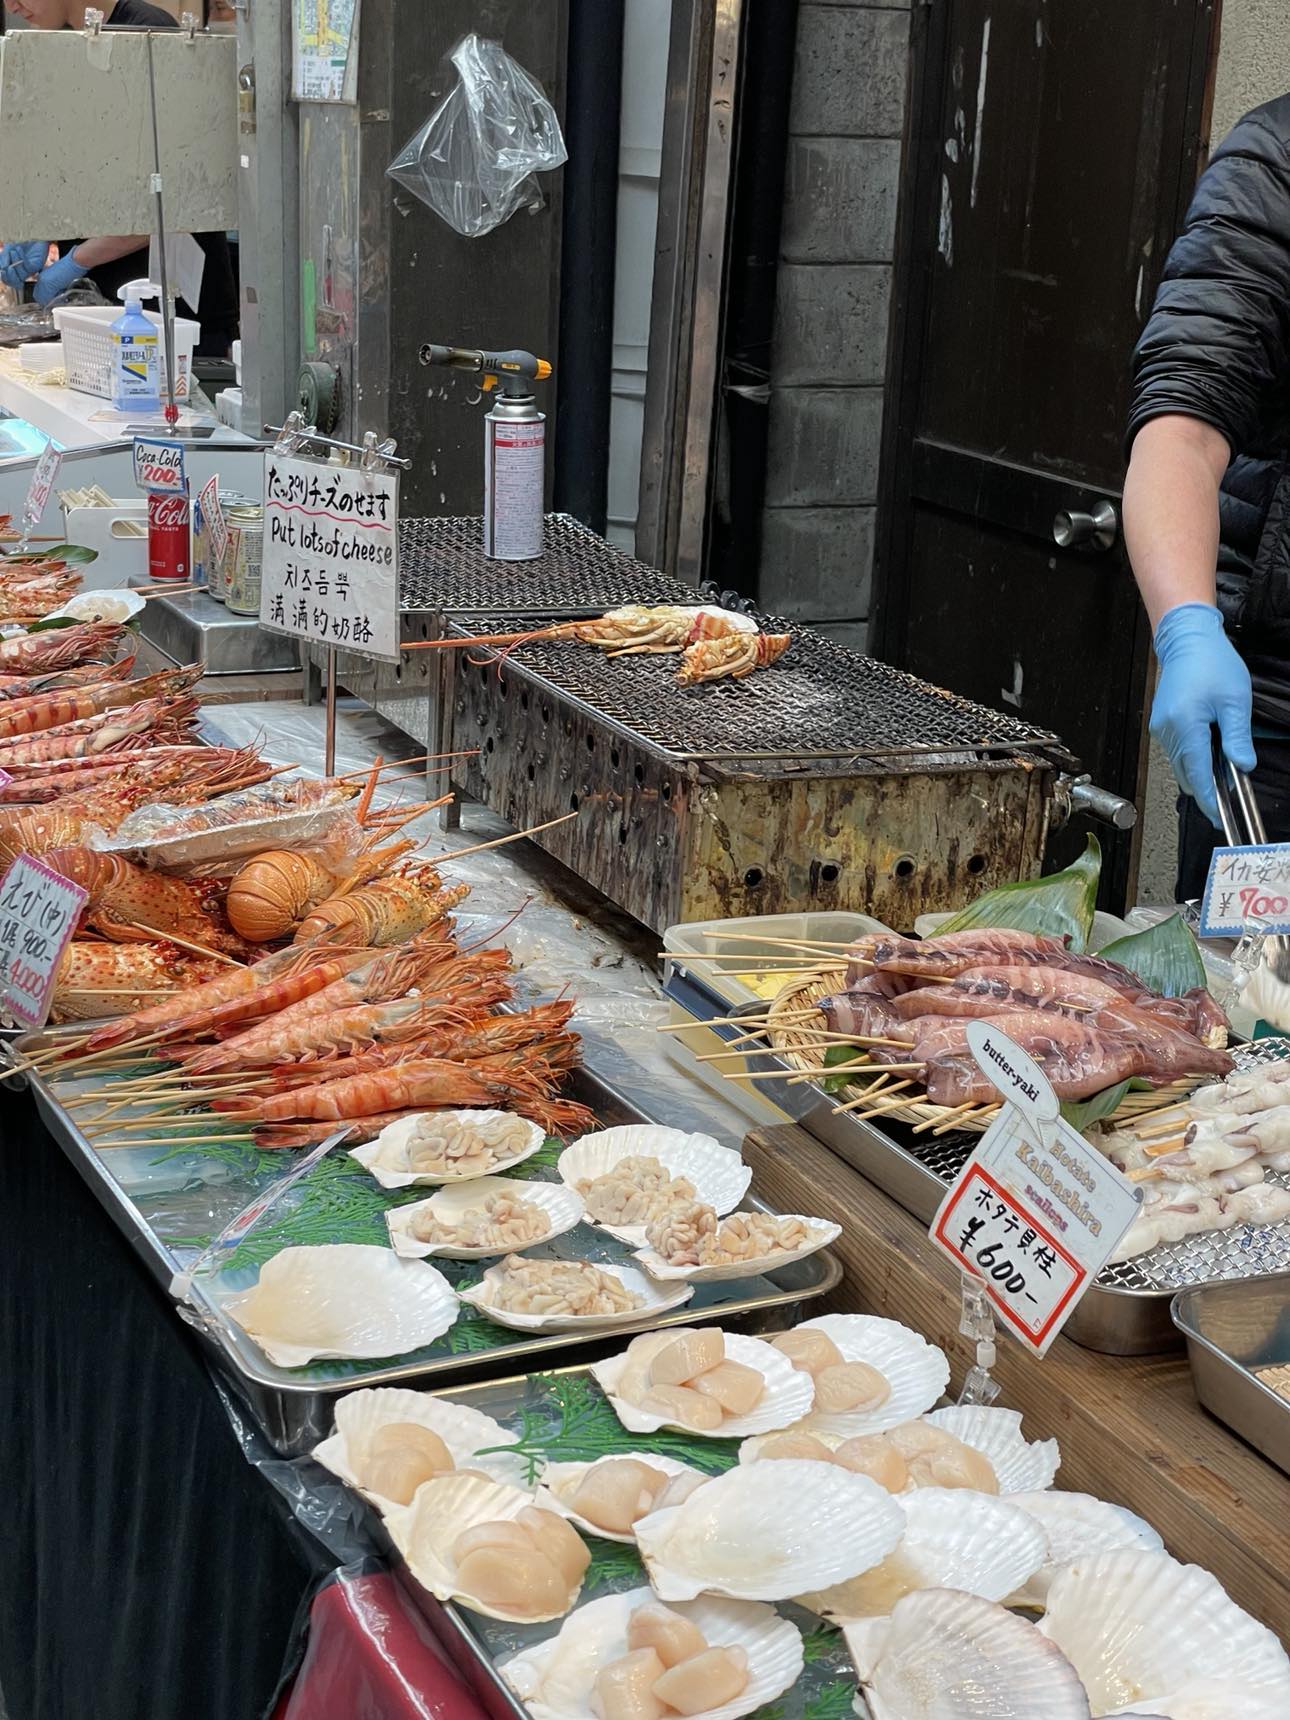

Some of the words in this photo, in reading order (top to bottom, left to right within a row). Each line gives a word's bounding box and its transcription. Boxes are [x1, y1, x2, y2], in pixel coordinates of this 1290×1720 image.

[136, 444, 182, 468] Coca-Cola
[267, 464, 391, 521] たっぷりチーズのせます
[271, 516, 296, 548] Put
[981, 1038, 1041, 1103] butter-yaki
[1014, 1139, 1104, 1238] Kaibashira
[1050, 1139, 1097, 1193] Hotate
[974, 1188, 1057, 1280] ホタテ貝柱
[1024, 1184, 1070, 1233] scallops
